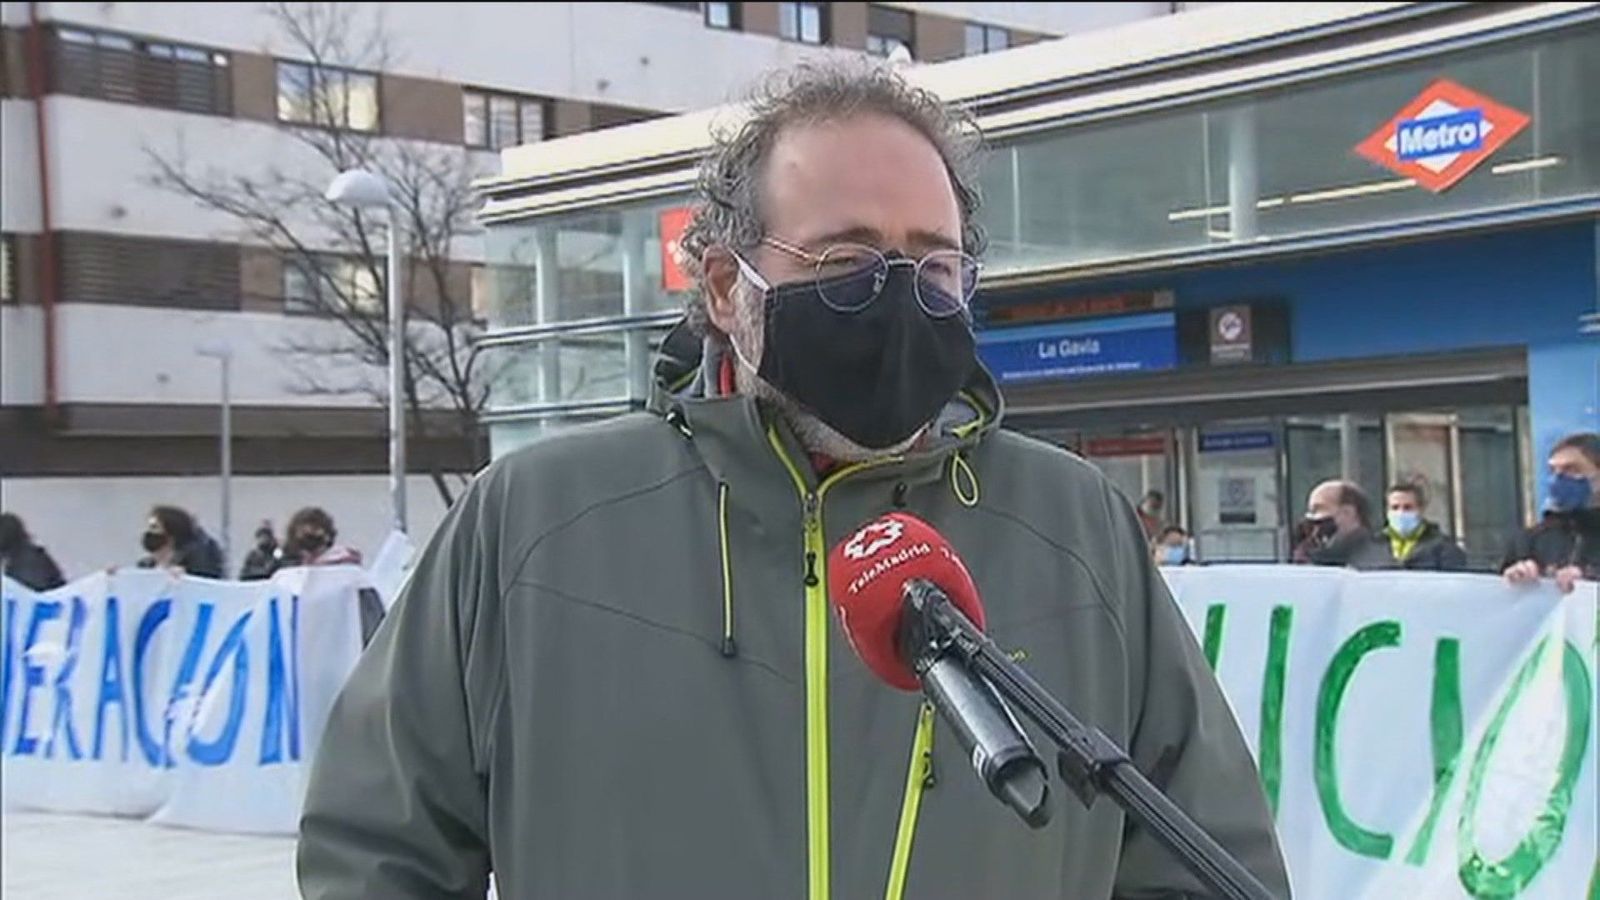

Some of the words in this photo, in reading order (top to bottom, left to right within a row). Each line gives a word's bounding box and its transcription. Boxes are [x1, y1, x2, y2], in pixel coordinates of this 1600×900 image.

[1400, 122, 1477, 154] Metro
[1038, 341, 1057, 358] La
[1060, 338, 1100, 357] Gavia
[847, 542, 932, 594] TeleMadrid
